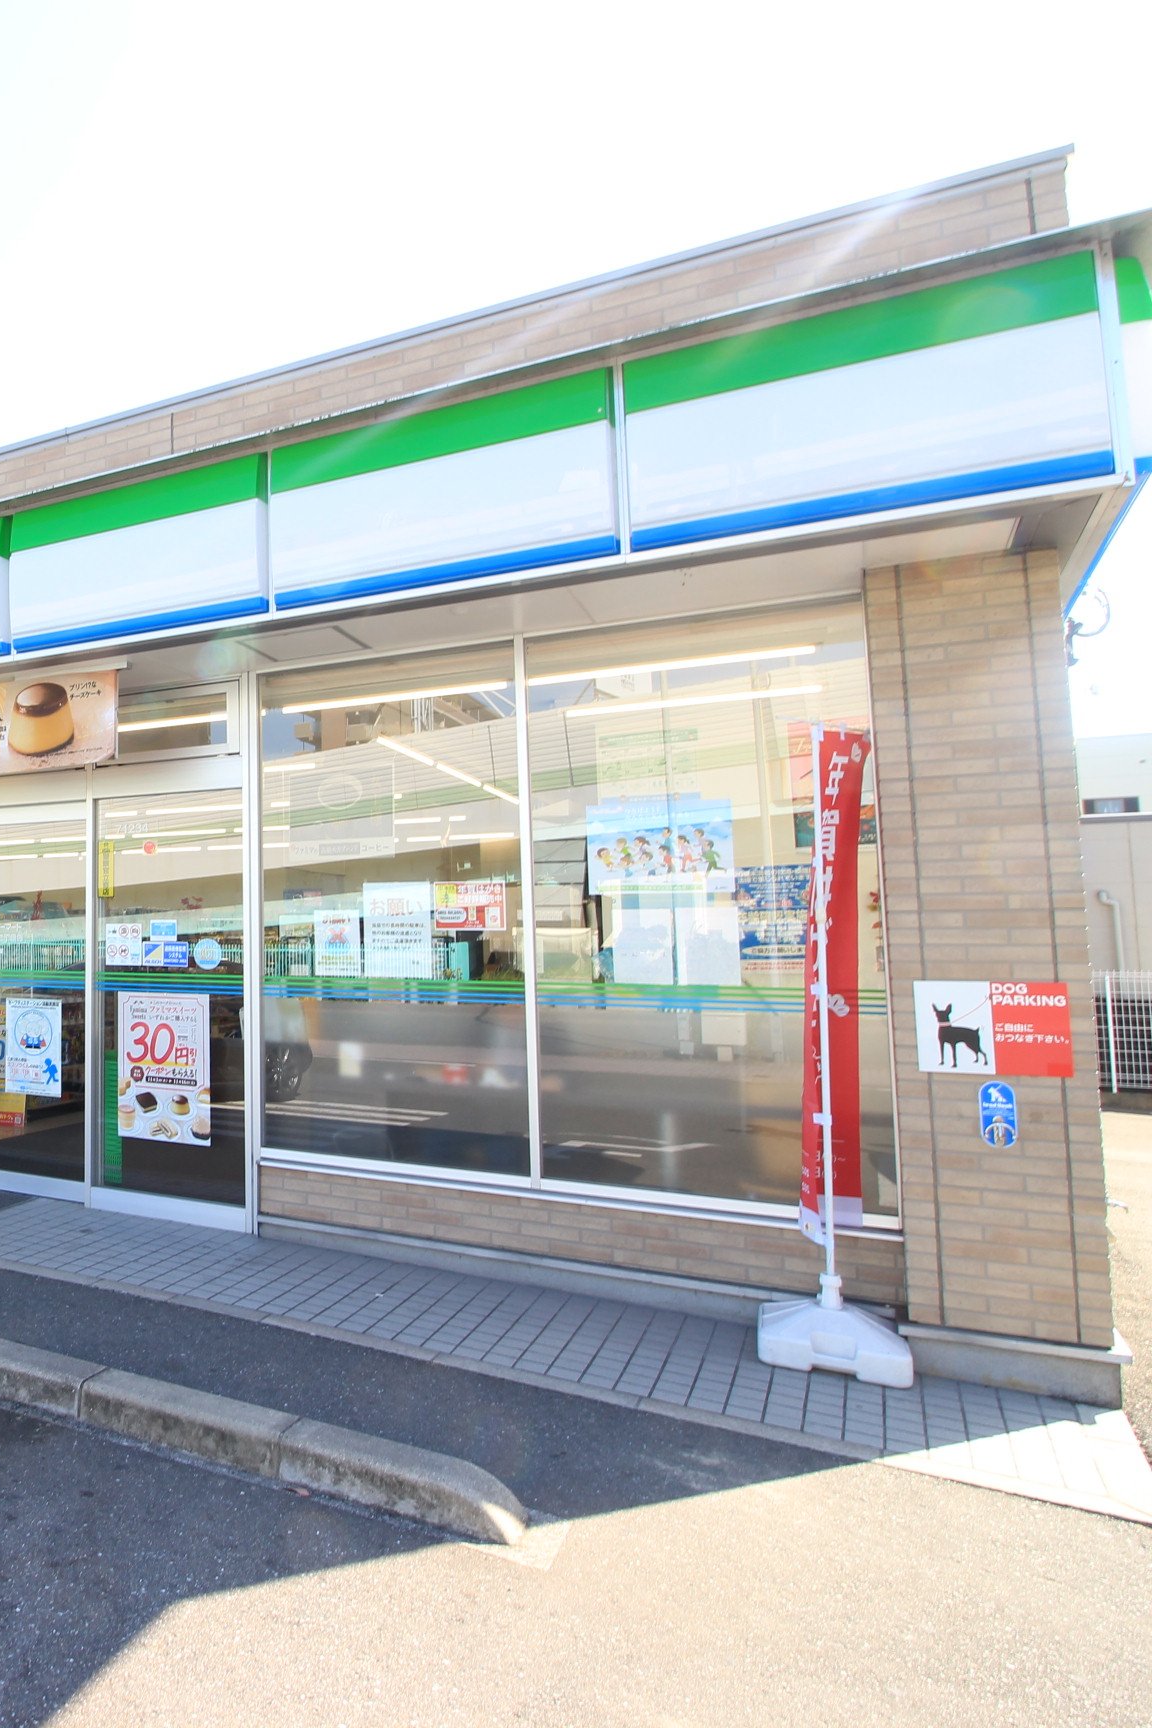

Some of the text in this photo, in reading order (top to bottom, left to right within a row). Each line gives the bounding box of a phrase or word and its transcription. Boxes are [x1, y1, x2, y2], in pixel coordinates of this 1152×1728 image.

[370, 897, 423, 917] お願い
[991, 983, 1028, 994] DOG
[992, 995, 1067, 1007] PARKING
[995, 1023, 1034, 1032] ご自由に
[995, 1033, 1070, 1044] おつなぎ下さい。
